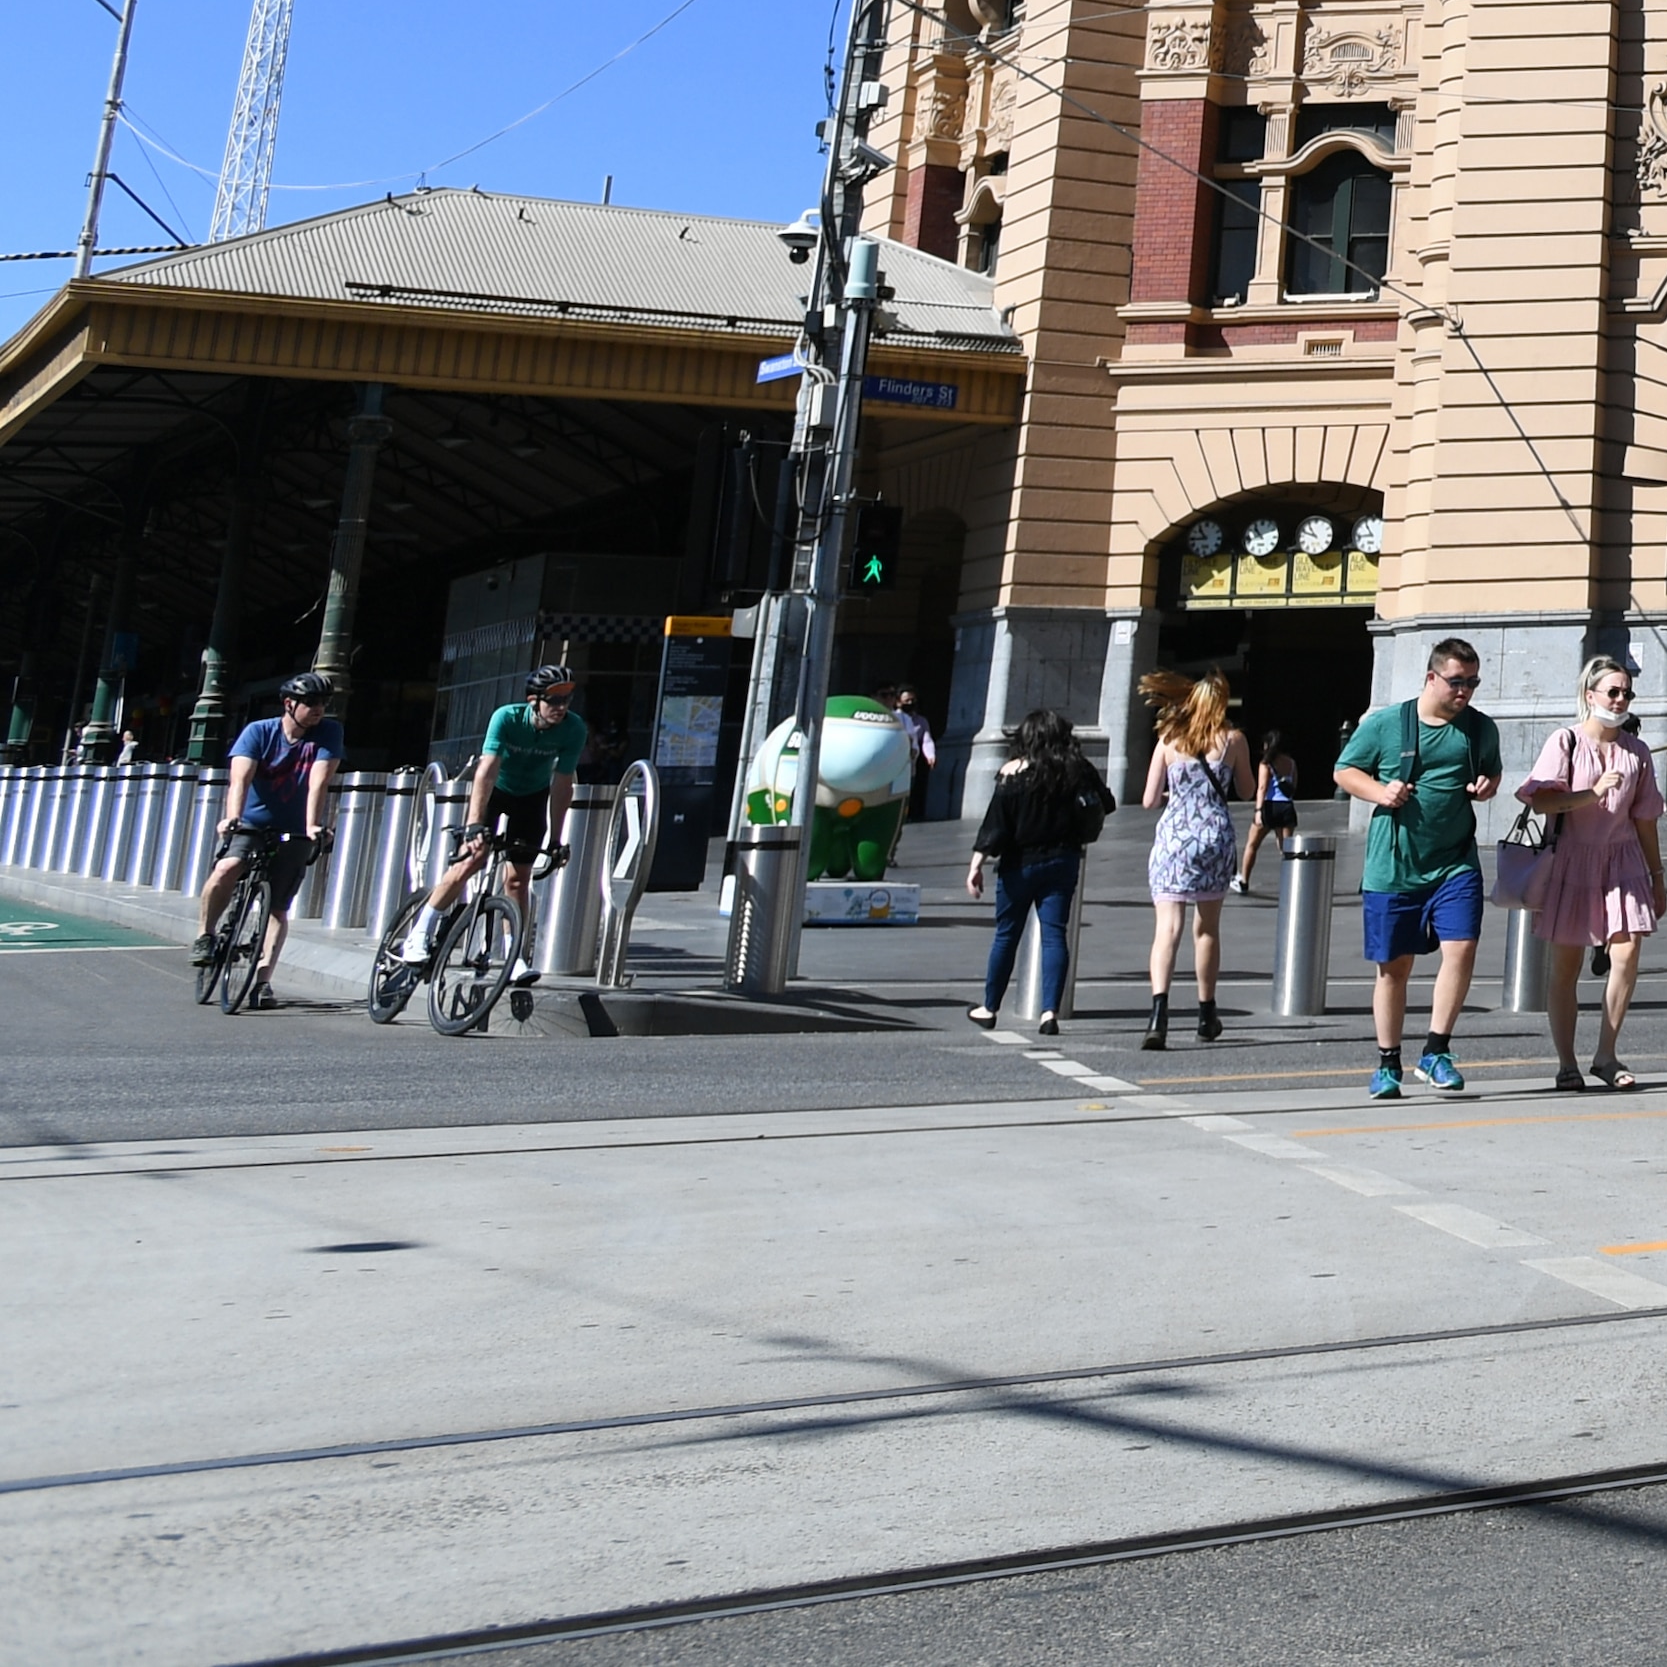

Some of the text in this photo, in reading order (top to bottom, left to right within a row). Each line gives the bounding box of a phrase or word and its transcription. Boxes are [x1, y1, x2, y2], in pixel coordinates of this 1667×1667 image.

[878, 379, 954, 400] Flinders St
[1239, 566, 1255, 575] LINE
[1350, 563, 1366, 572] LINE
[1294, 572, 1310, 581] LINE
